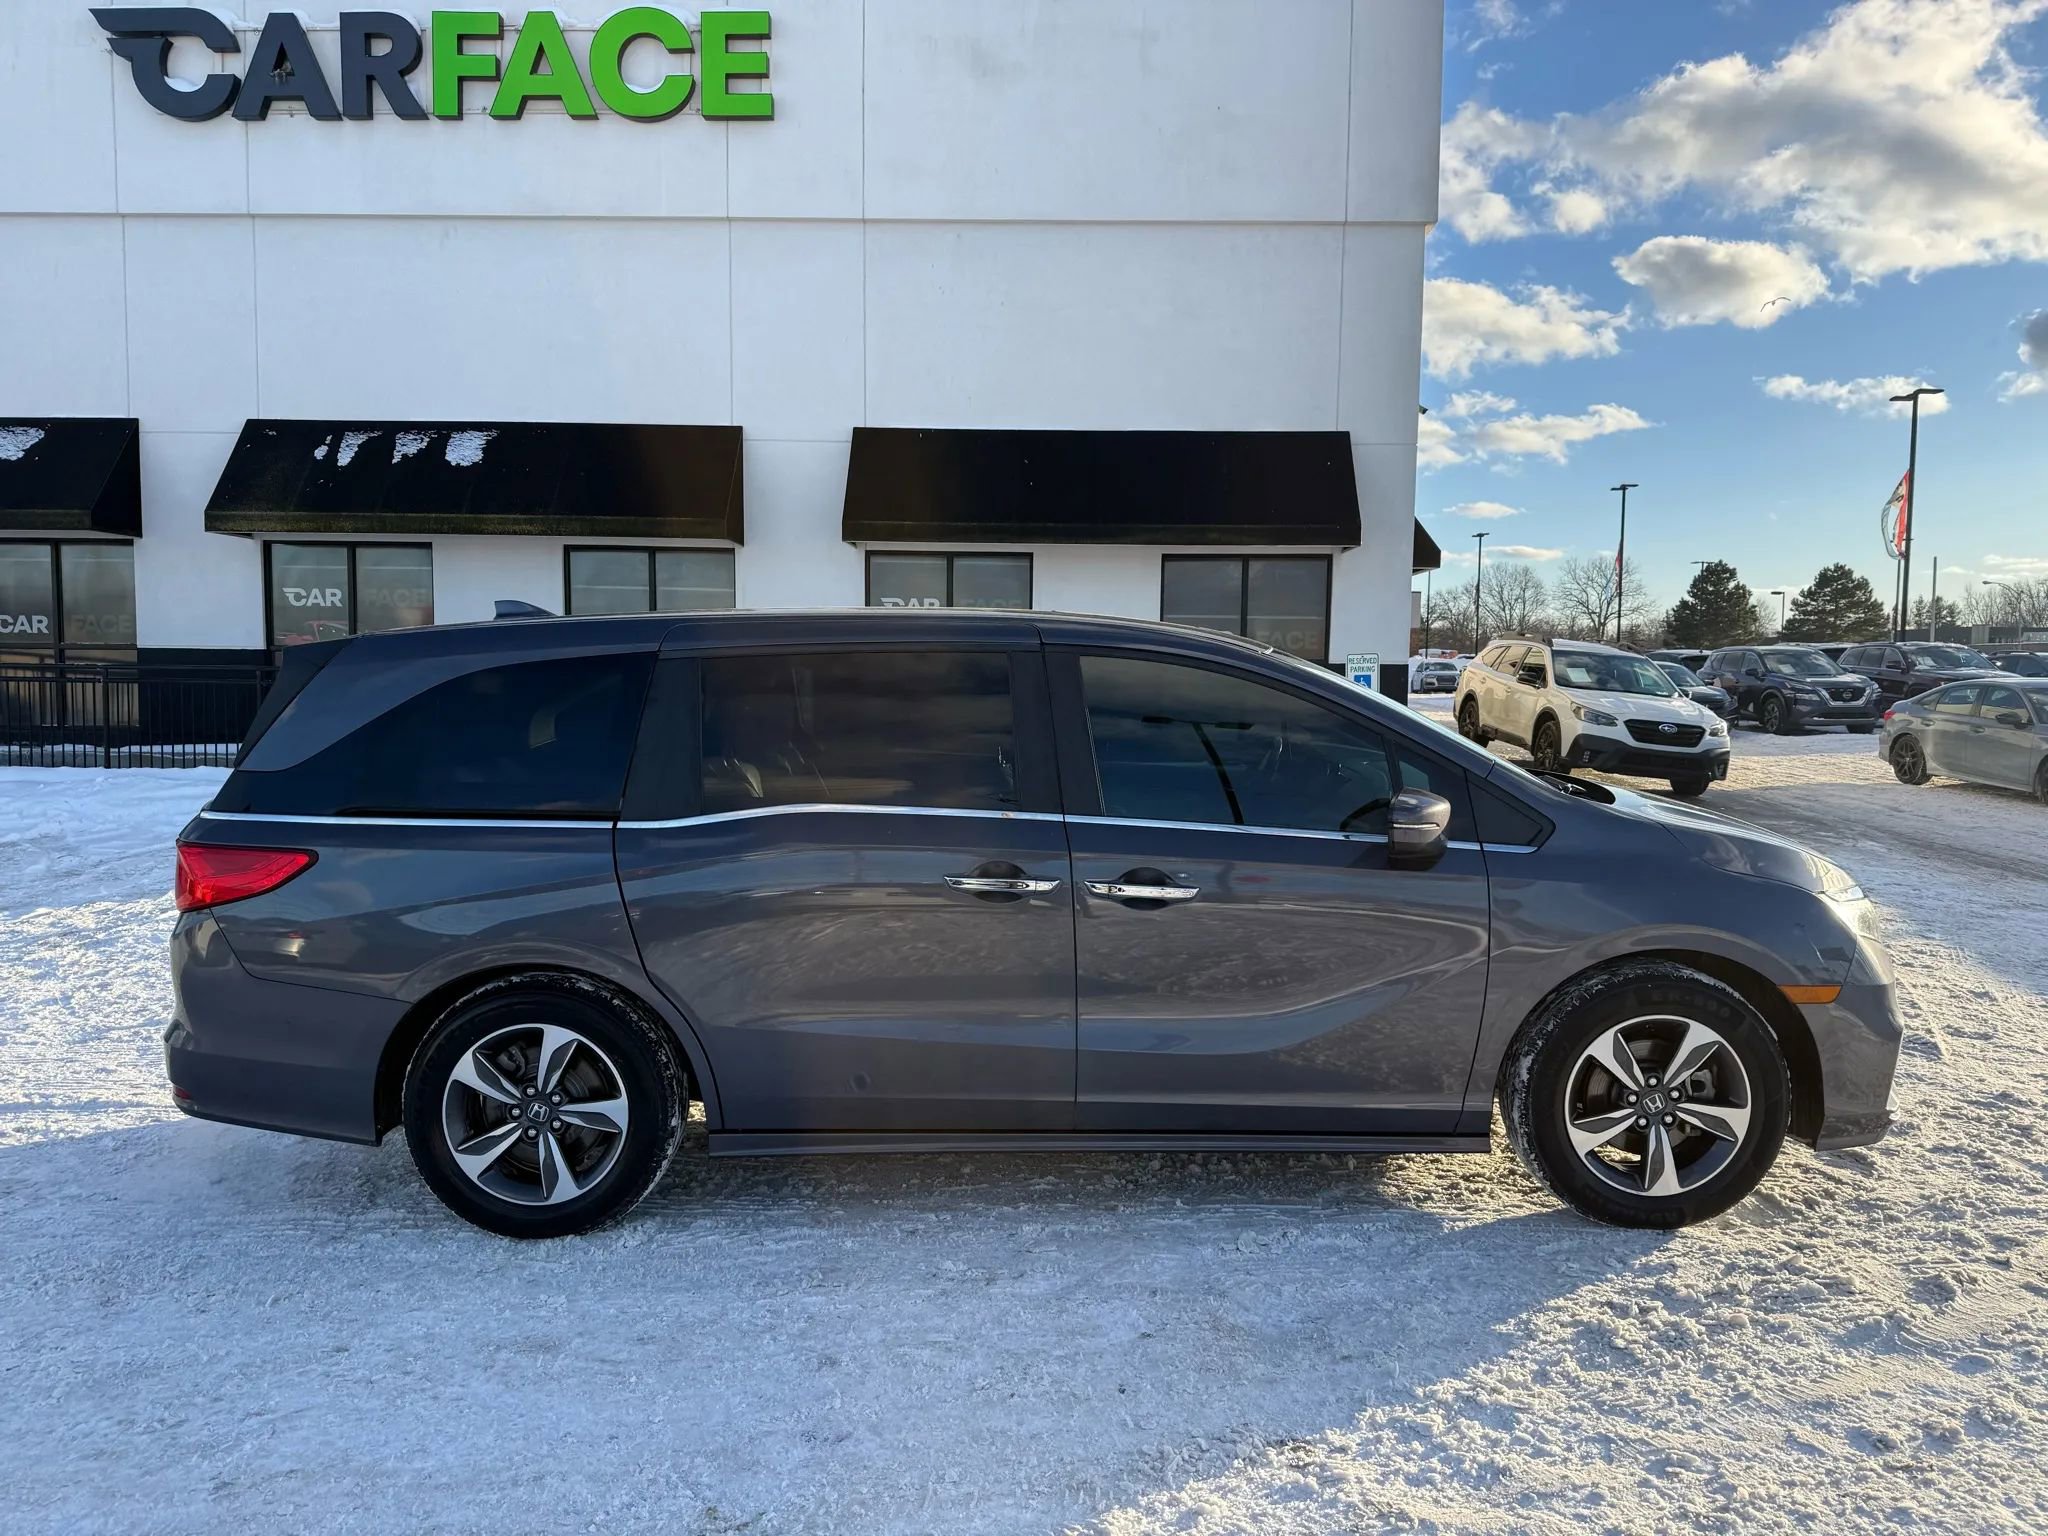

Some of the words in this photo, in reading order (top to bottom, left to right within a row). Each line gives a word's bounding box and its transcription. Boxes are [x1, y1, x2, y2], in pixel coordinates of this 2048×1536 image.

[88, 6, 774, 121] CARFACE
[282, 587, 343, 607] CAR
[366, 588, 428, 607] FACE
[71, 614, 133, 633] FACE
[1348, 657, 1377, 665] RESERVED
[1350, 665, 1376, 673] PARKING
